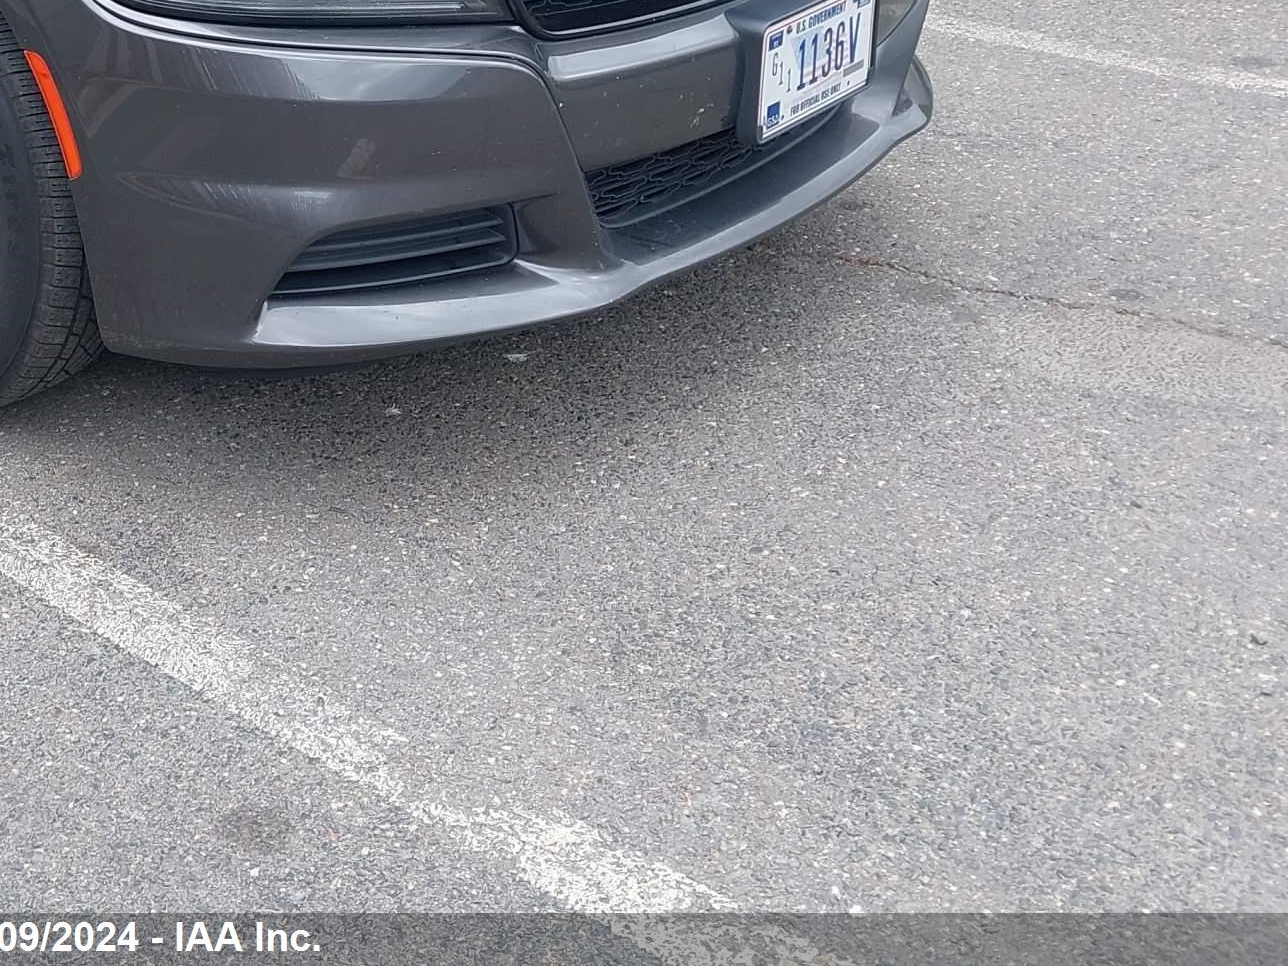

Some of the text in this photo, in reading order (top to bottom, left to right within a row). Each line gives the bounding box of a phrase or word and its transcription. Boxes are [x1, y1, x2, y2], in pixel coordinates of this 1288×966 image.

[796, 0, 847, 34] U.S. GOVERNMENT
[796, 12, 861, 91] 1136V
